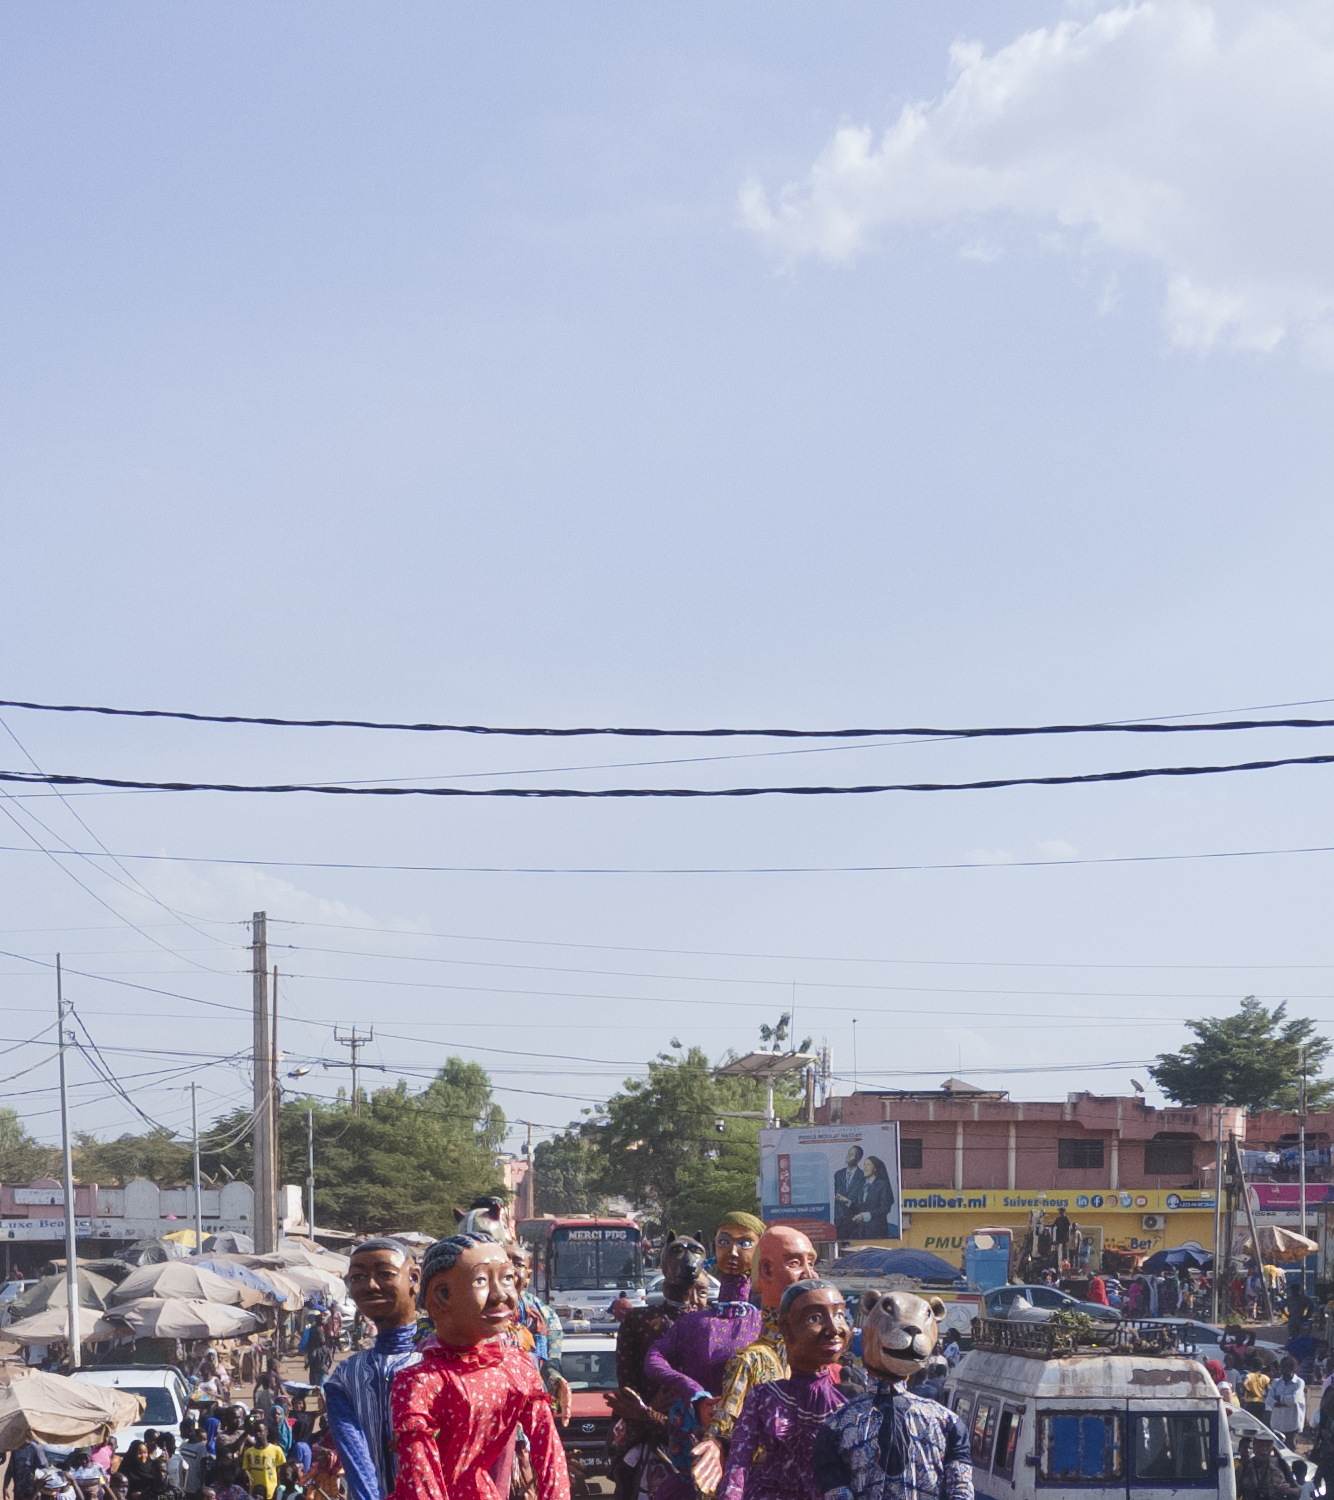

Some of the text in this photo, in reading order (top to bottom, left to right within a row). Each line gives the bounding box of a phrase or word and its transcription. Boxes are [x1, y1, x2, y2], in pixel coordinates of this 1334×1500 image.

[1003, 1196, 1069, 1207] Suivez-nous
[568, 1230, 602, 1241] MERCI
[924, 1236, 963, 1248] PMU
